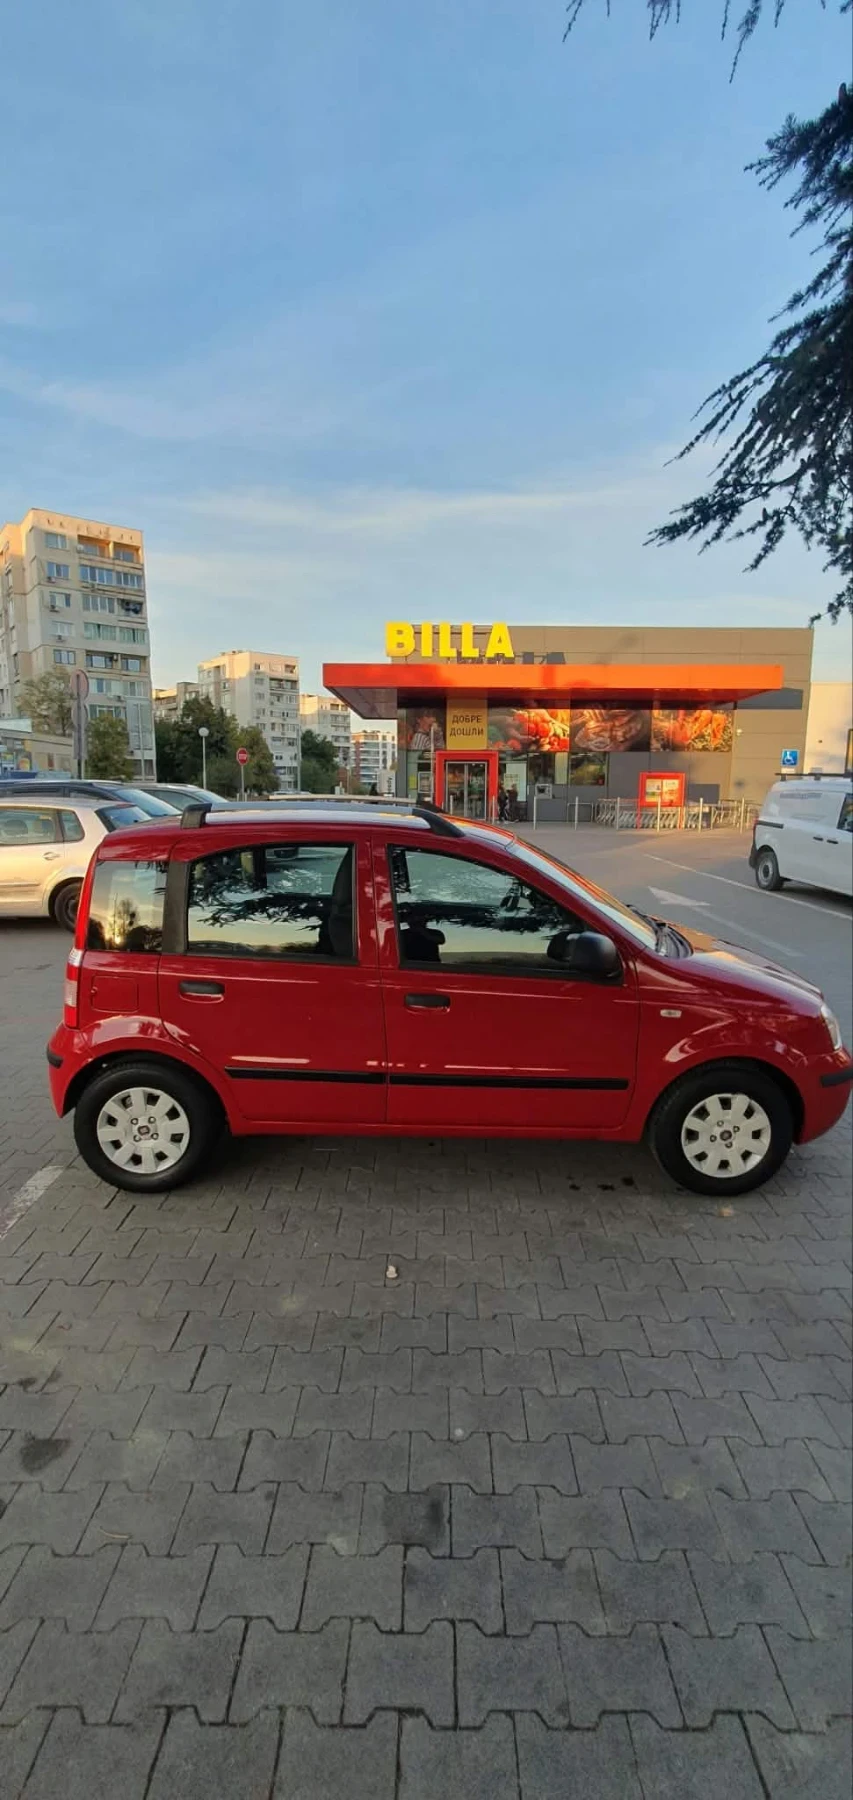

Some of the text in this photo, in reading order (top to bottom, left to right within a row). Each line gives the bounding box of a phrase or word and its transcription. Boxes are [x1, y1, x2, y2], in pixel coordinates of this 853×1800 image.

[386, 622, 514, 657] BILLA
[451, 714, 483, 724] ДОБРЕ
[449, 727, 485, 737] ДОШЛИ
